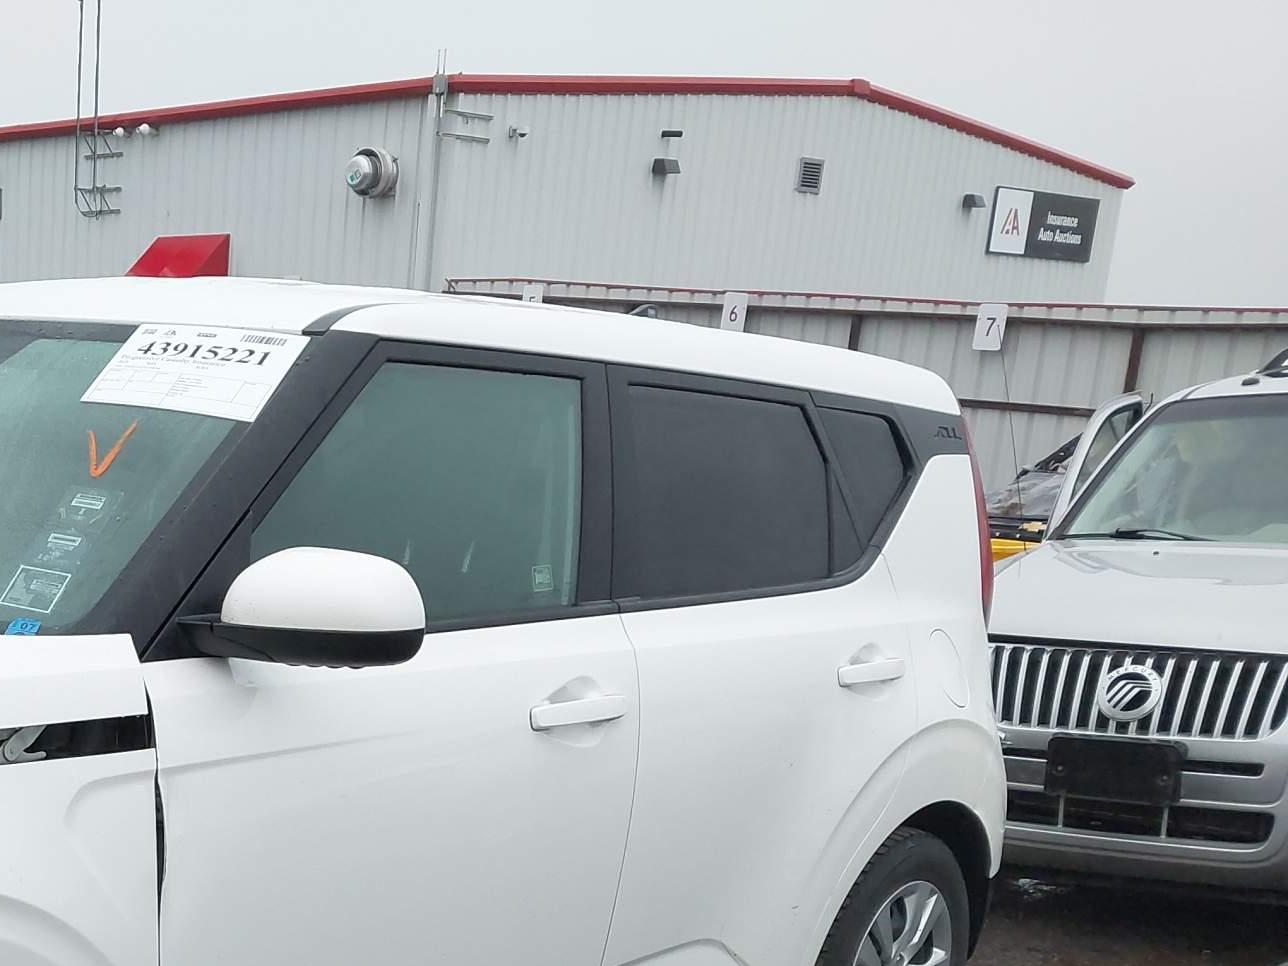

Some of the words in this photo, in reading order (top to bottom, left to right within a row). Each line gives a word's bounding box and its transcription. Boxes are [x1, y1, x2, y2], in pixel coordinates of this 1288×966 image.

[1047, 210, 1078, 227] Insurance
[1038, 227, 1054, 241] Auto
[1054, 229, 1082, 244] Auctions
[728, 304, 738, 322] 6
[985, 317, 997, 337] 7
[137, 340, 271, 366] 43915221
